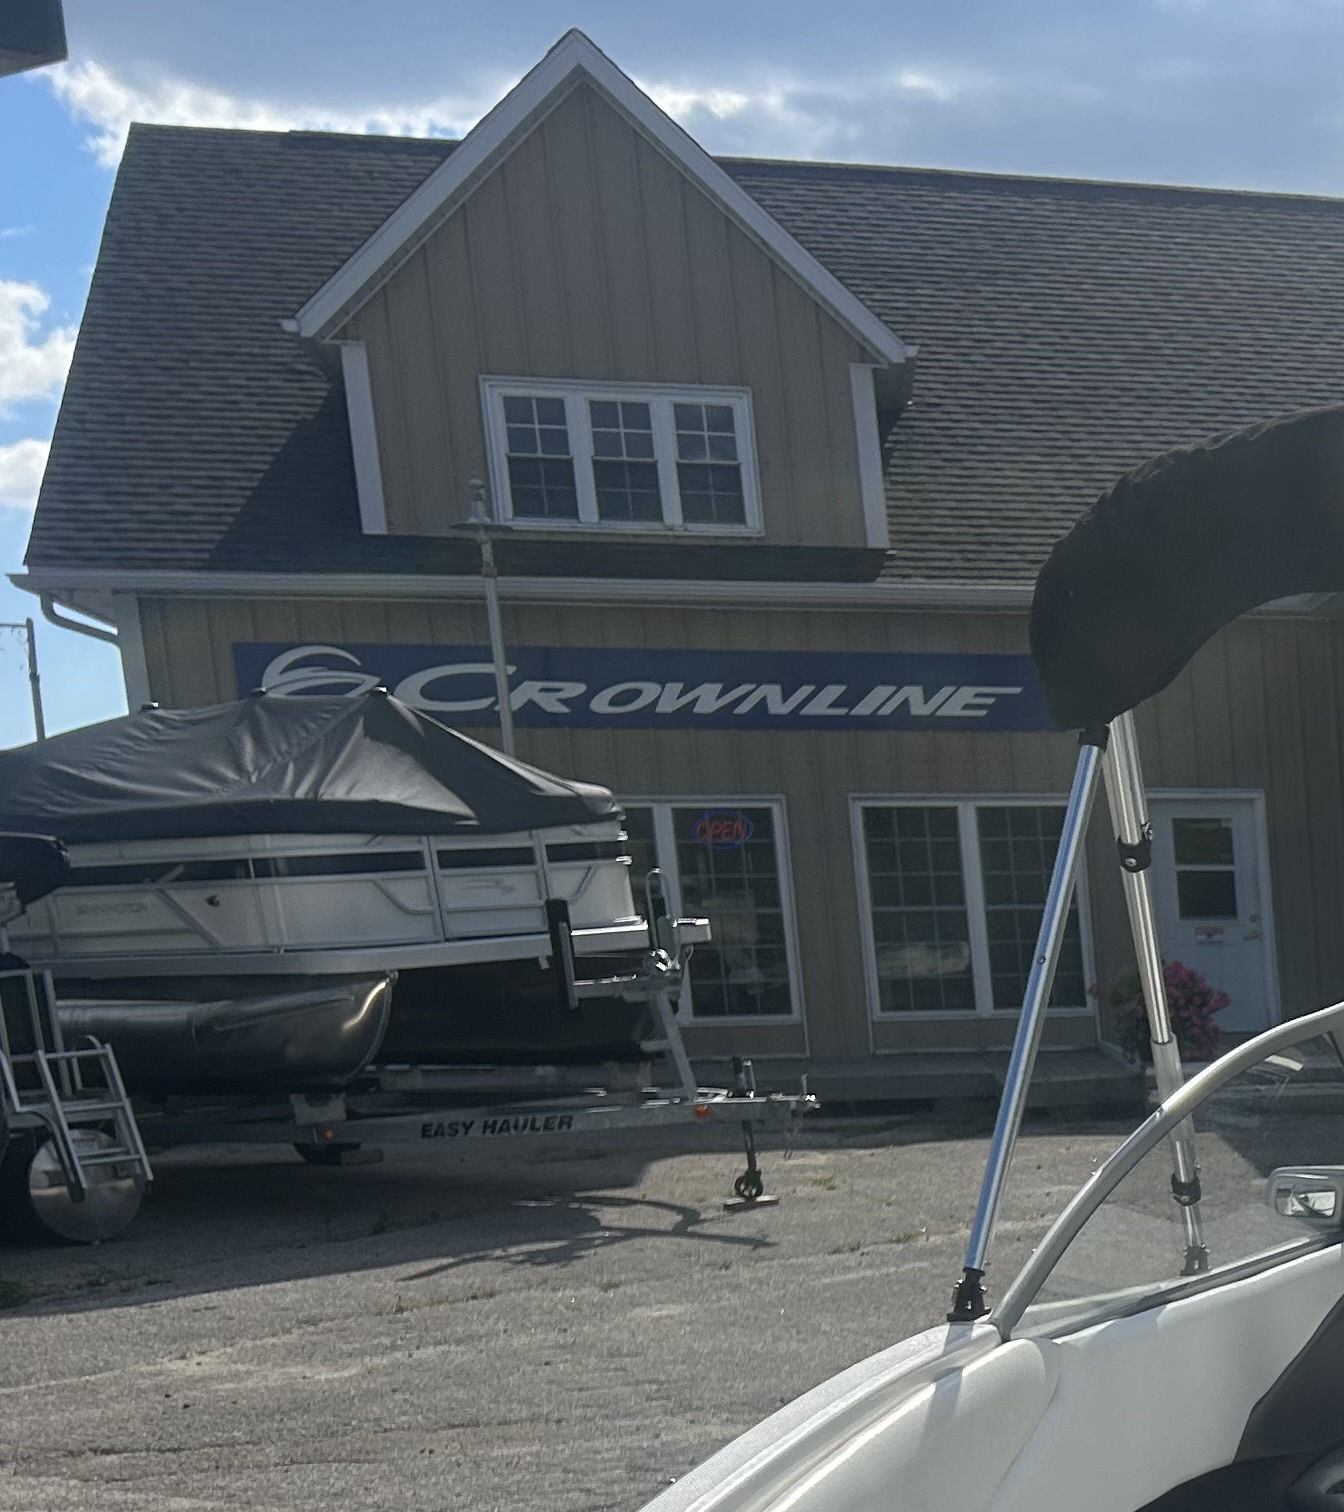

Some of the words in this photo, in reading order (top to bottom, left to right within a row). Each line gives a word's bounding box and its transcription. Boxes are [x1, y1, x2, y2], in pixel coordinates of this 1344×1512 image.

[394, 663, 1023, 718] CROWNLINE
[695, 820, 748, 841] OPEN
[421, 1120, 474, 1138] EASY
[481, 1115, 574, 1136] HAULER
